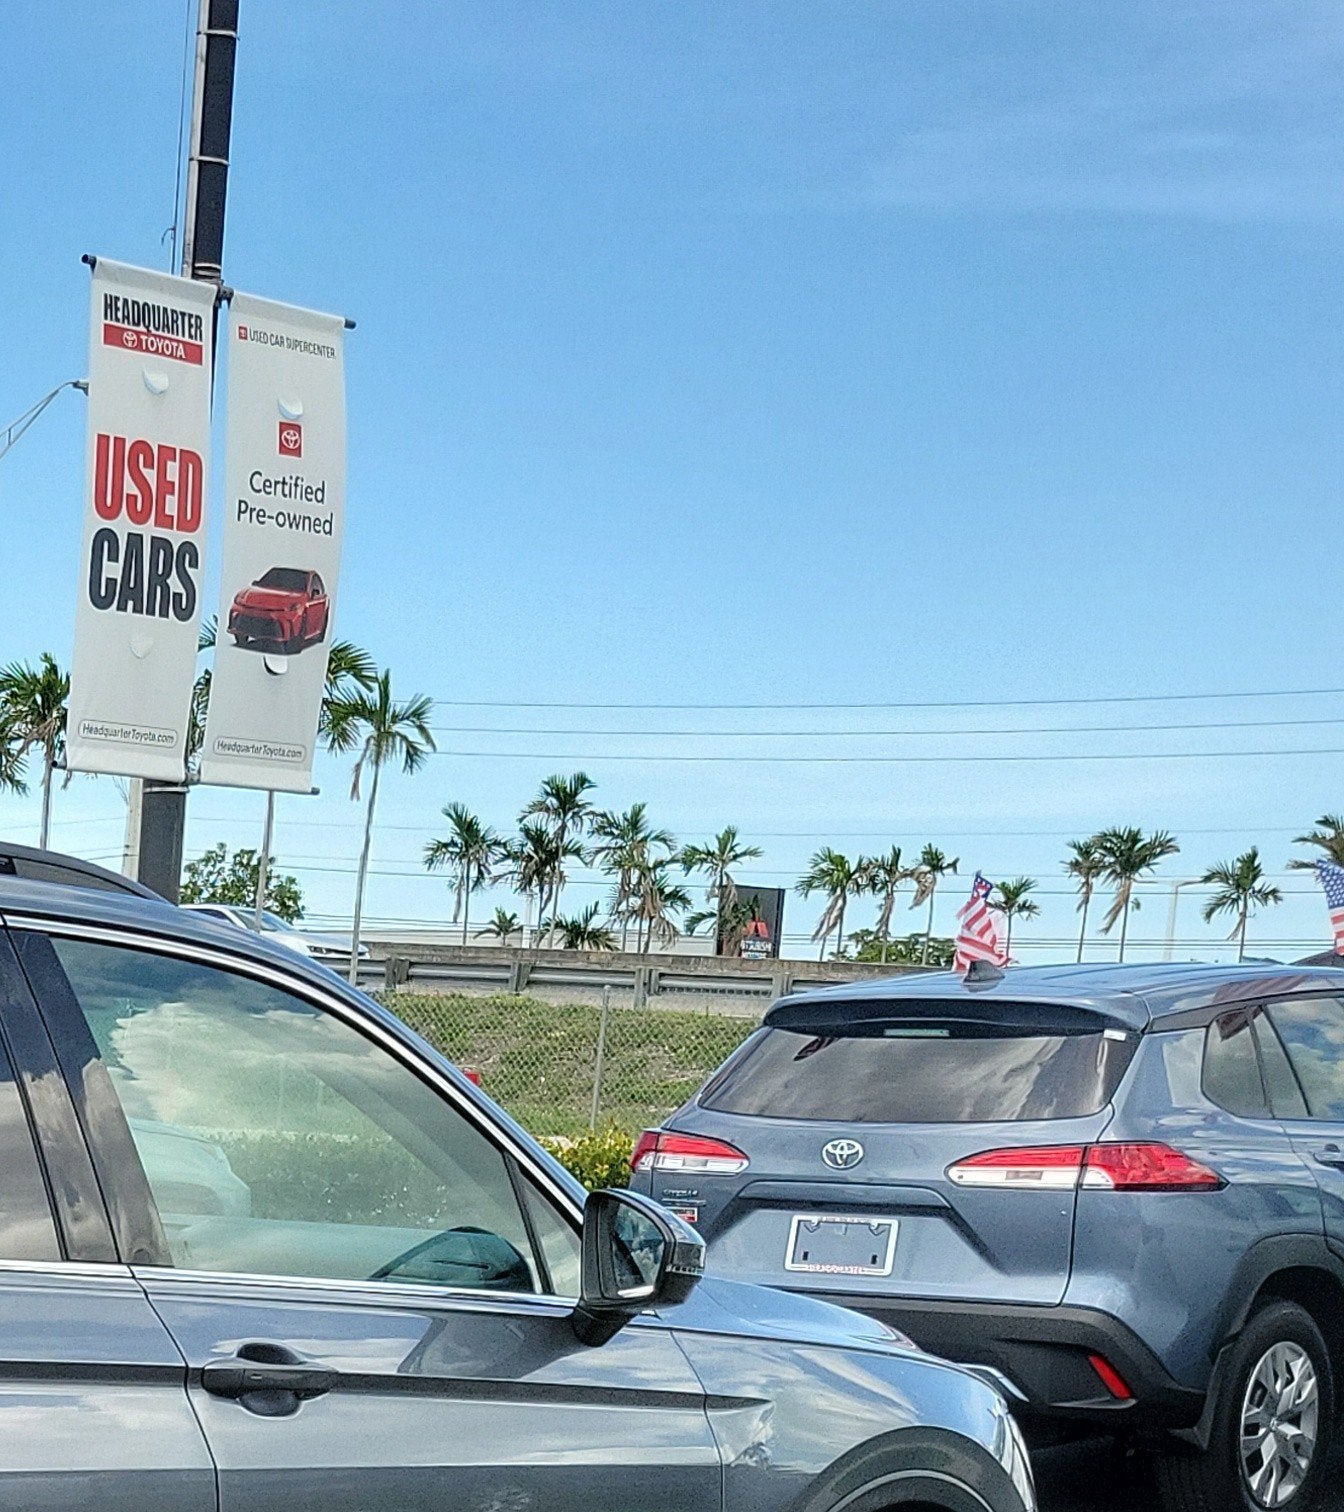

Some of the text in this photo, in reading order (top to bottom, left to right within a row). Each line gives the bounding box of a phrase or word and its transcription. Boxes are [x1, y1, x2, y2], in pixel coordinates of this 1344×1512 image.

[103, 292, 203, 342] HEADQUARTER
[140, 335, 186, 359] TOYOTA
[249, 329, 336, 359] USED CAR SUPERCENTER
[94, 433, 203, 533] USED
[249, 470, 325, 504] Certified
[237, 499, 334, 536] Pre-owned
[88, 527, 199, 622] CARS
[82, 724, 174, 744] HeadquarterToyota.com
